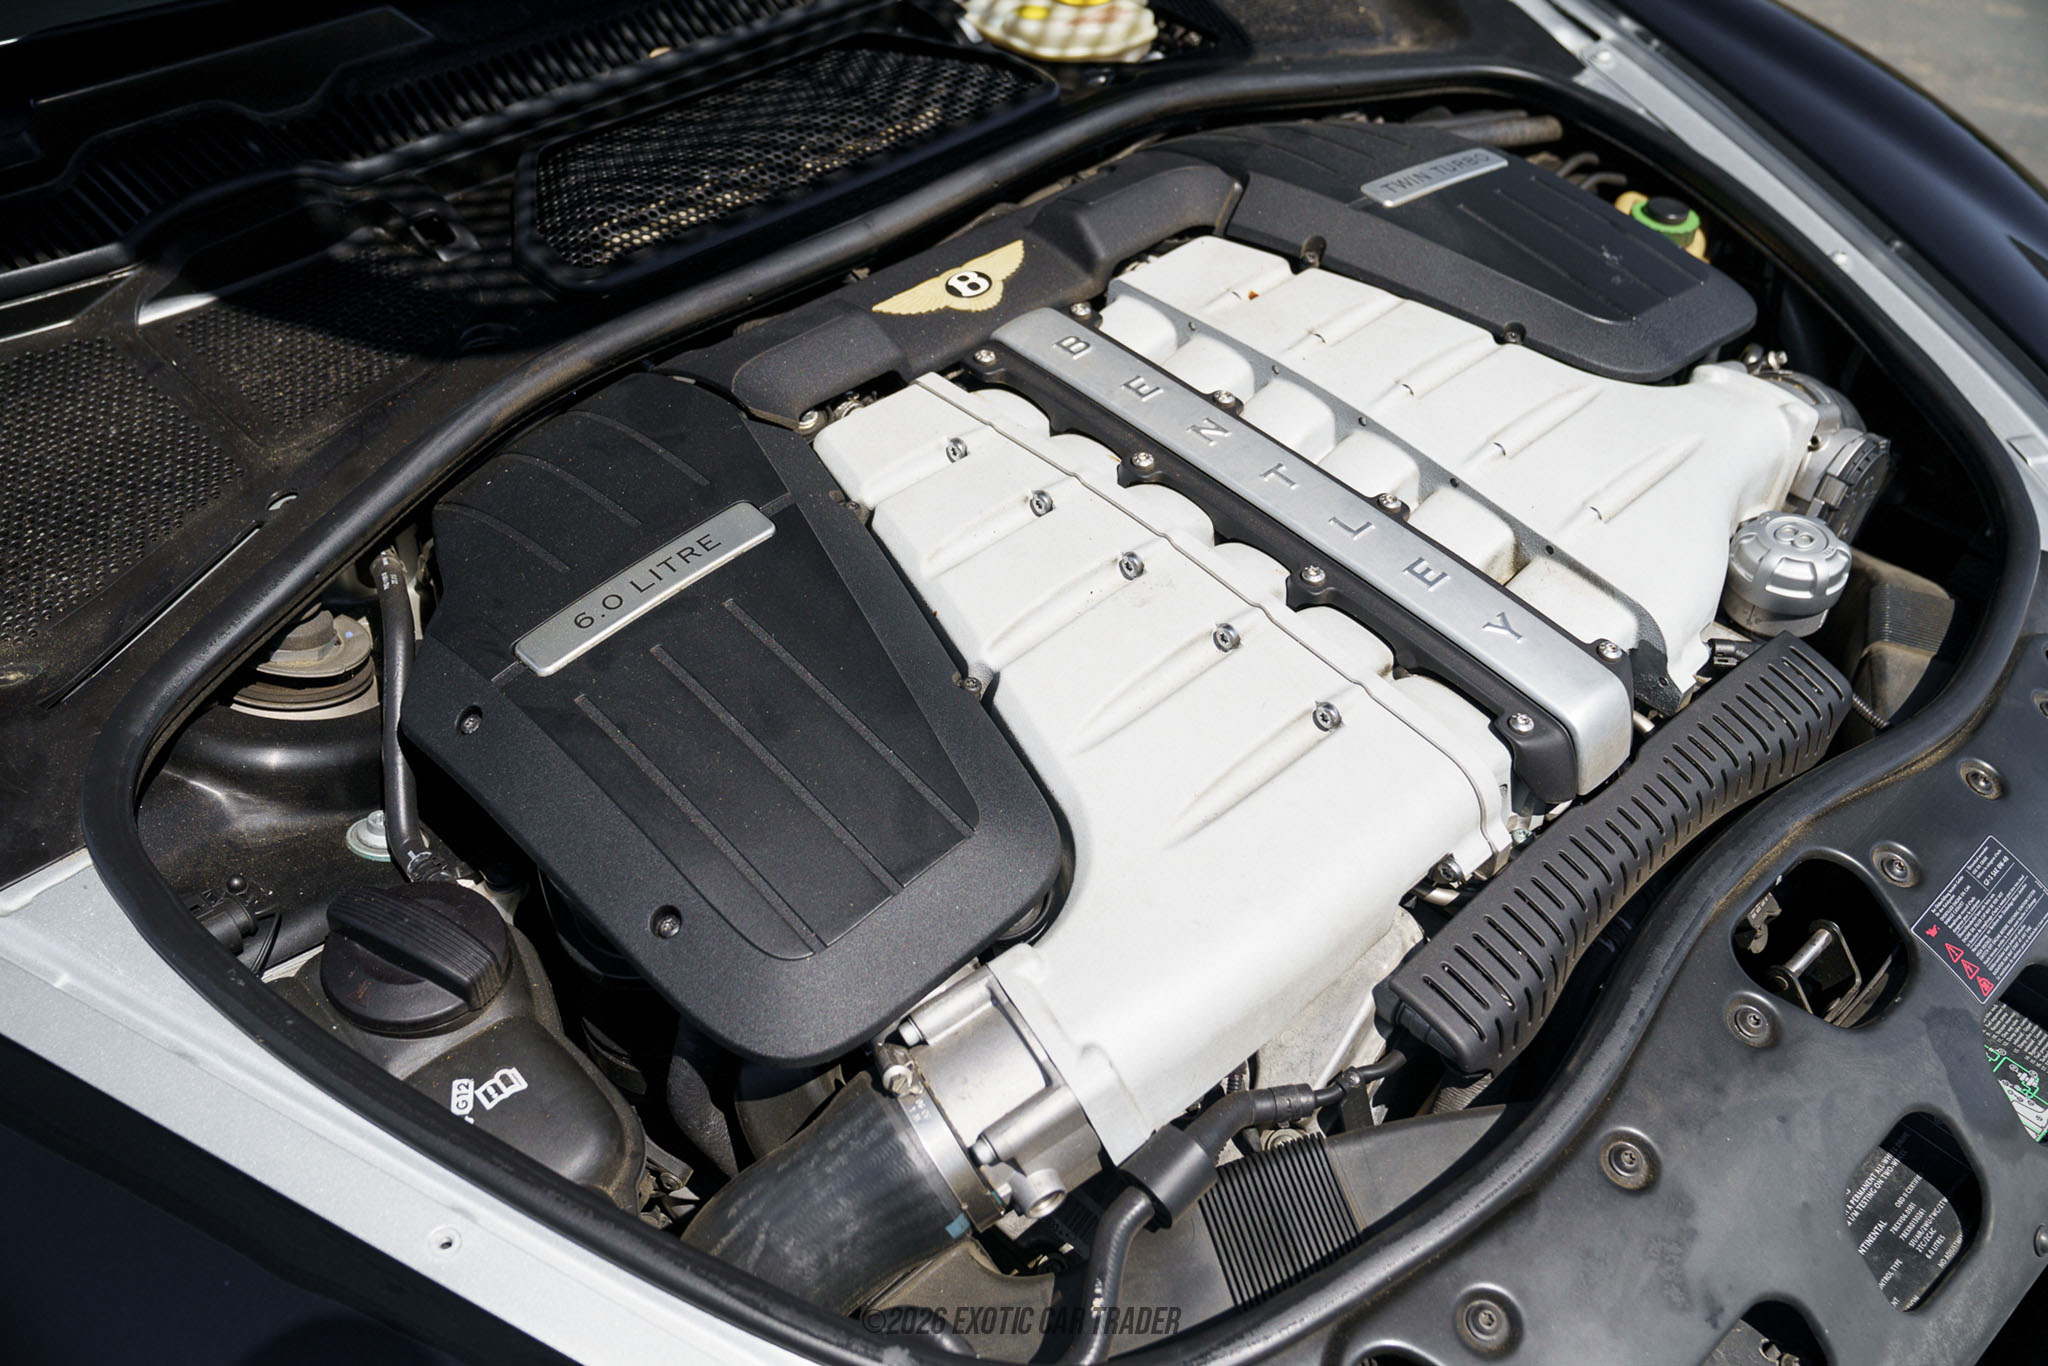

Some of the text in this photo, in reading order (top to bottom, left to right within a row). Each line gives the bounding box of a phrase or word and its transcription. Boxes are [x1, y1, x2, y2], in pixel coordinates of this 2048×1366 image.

[1380, 152, 1490, 194] TWIN TURBO
[1052, 335, 1524, 642] BENTLEY
[573, 533, 722, 629] 6.0 LITRE
[456, 1081, 470, 1110] G12
[1848, 1172, 1877, 1205] PERMANENT
[1855, 1186, 1877, 1211] TESTING
[1872, 1177, 1885, 1189] ON
[1904, 1173, 1923, 1194] CERTIFIE
[1930, 1233, 1946, 1251] LITRES
[1889, 1257, 1903, 1272] TYPE
[1936, 1257, 1948, 1268] NO
